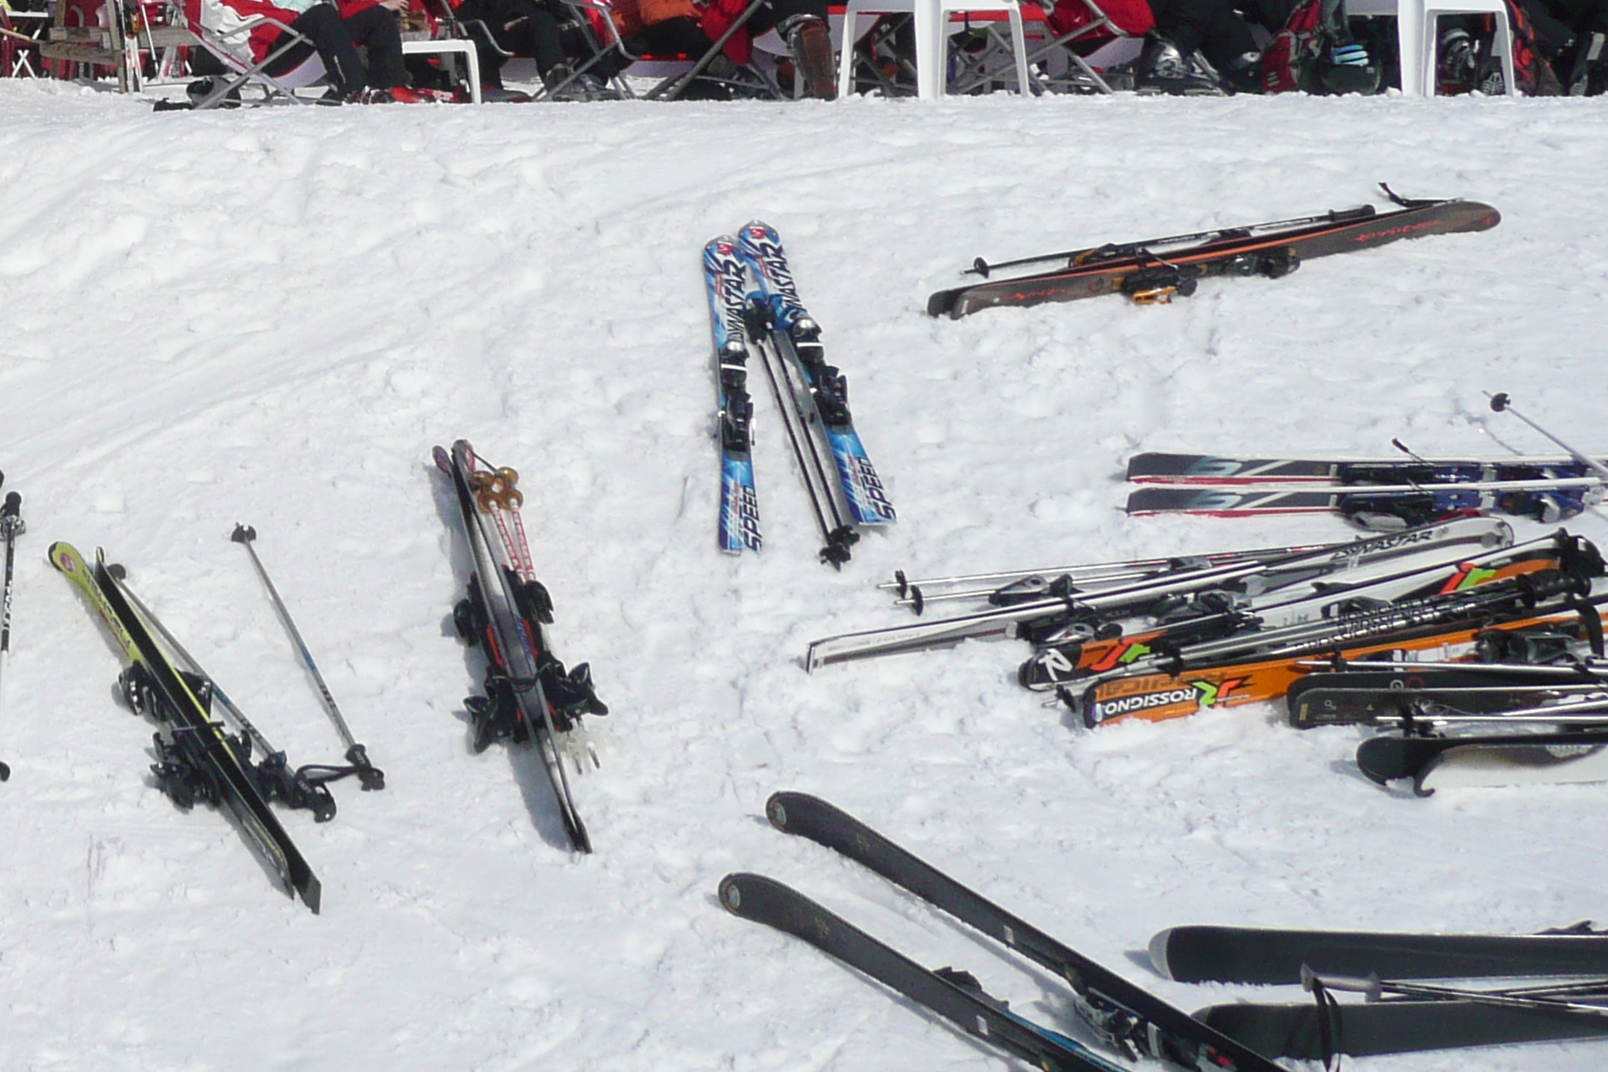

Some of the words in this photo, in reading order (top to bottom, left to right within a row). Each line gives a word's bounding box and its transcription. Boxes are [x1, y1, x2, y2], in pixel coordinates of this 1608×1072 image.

[741, 484, 764, 553] SPEED
[855, 456, 897, 520] SPEED
[1104, 687, 1197, 716] ROSSIGNO
